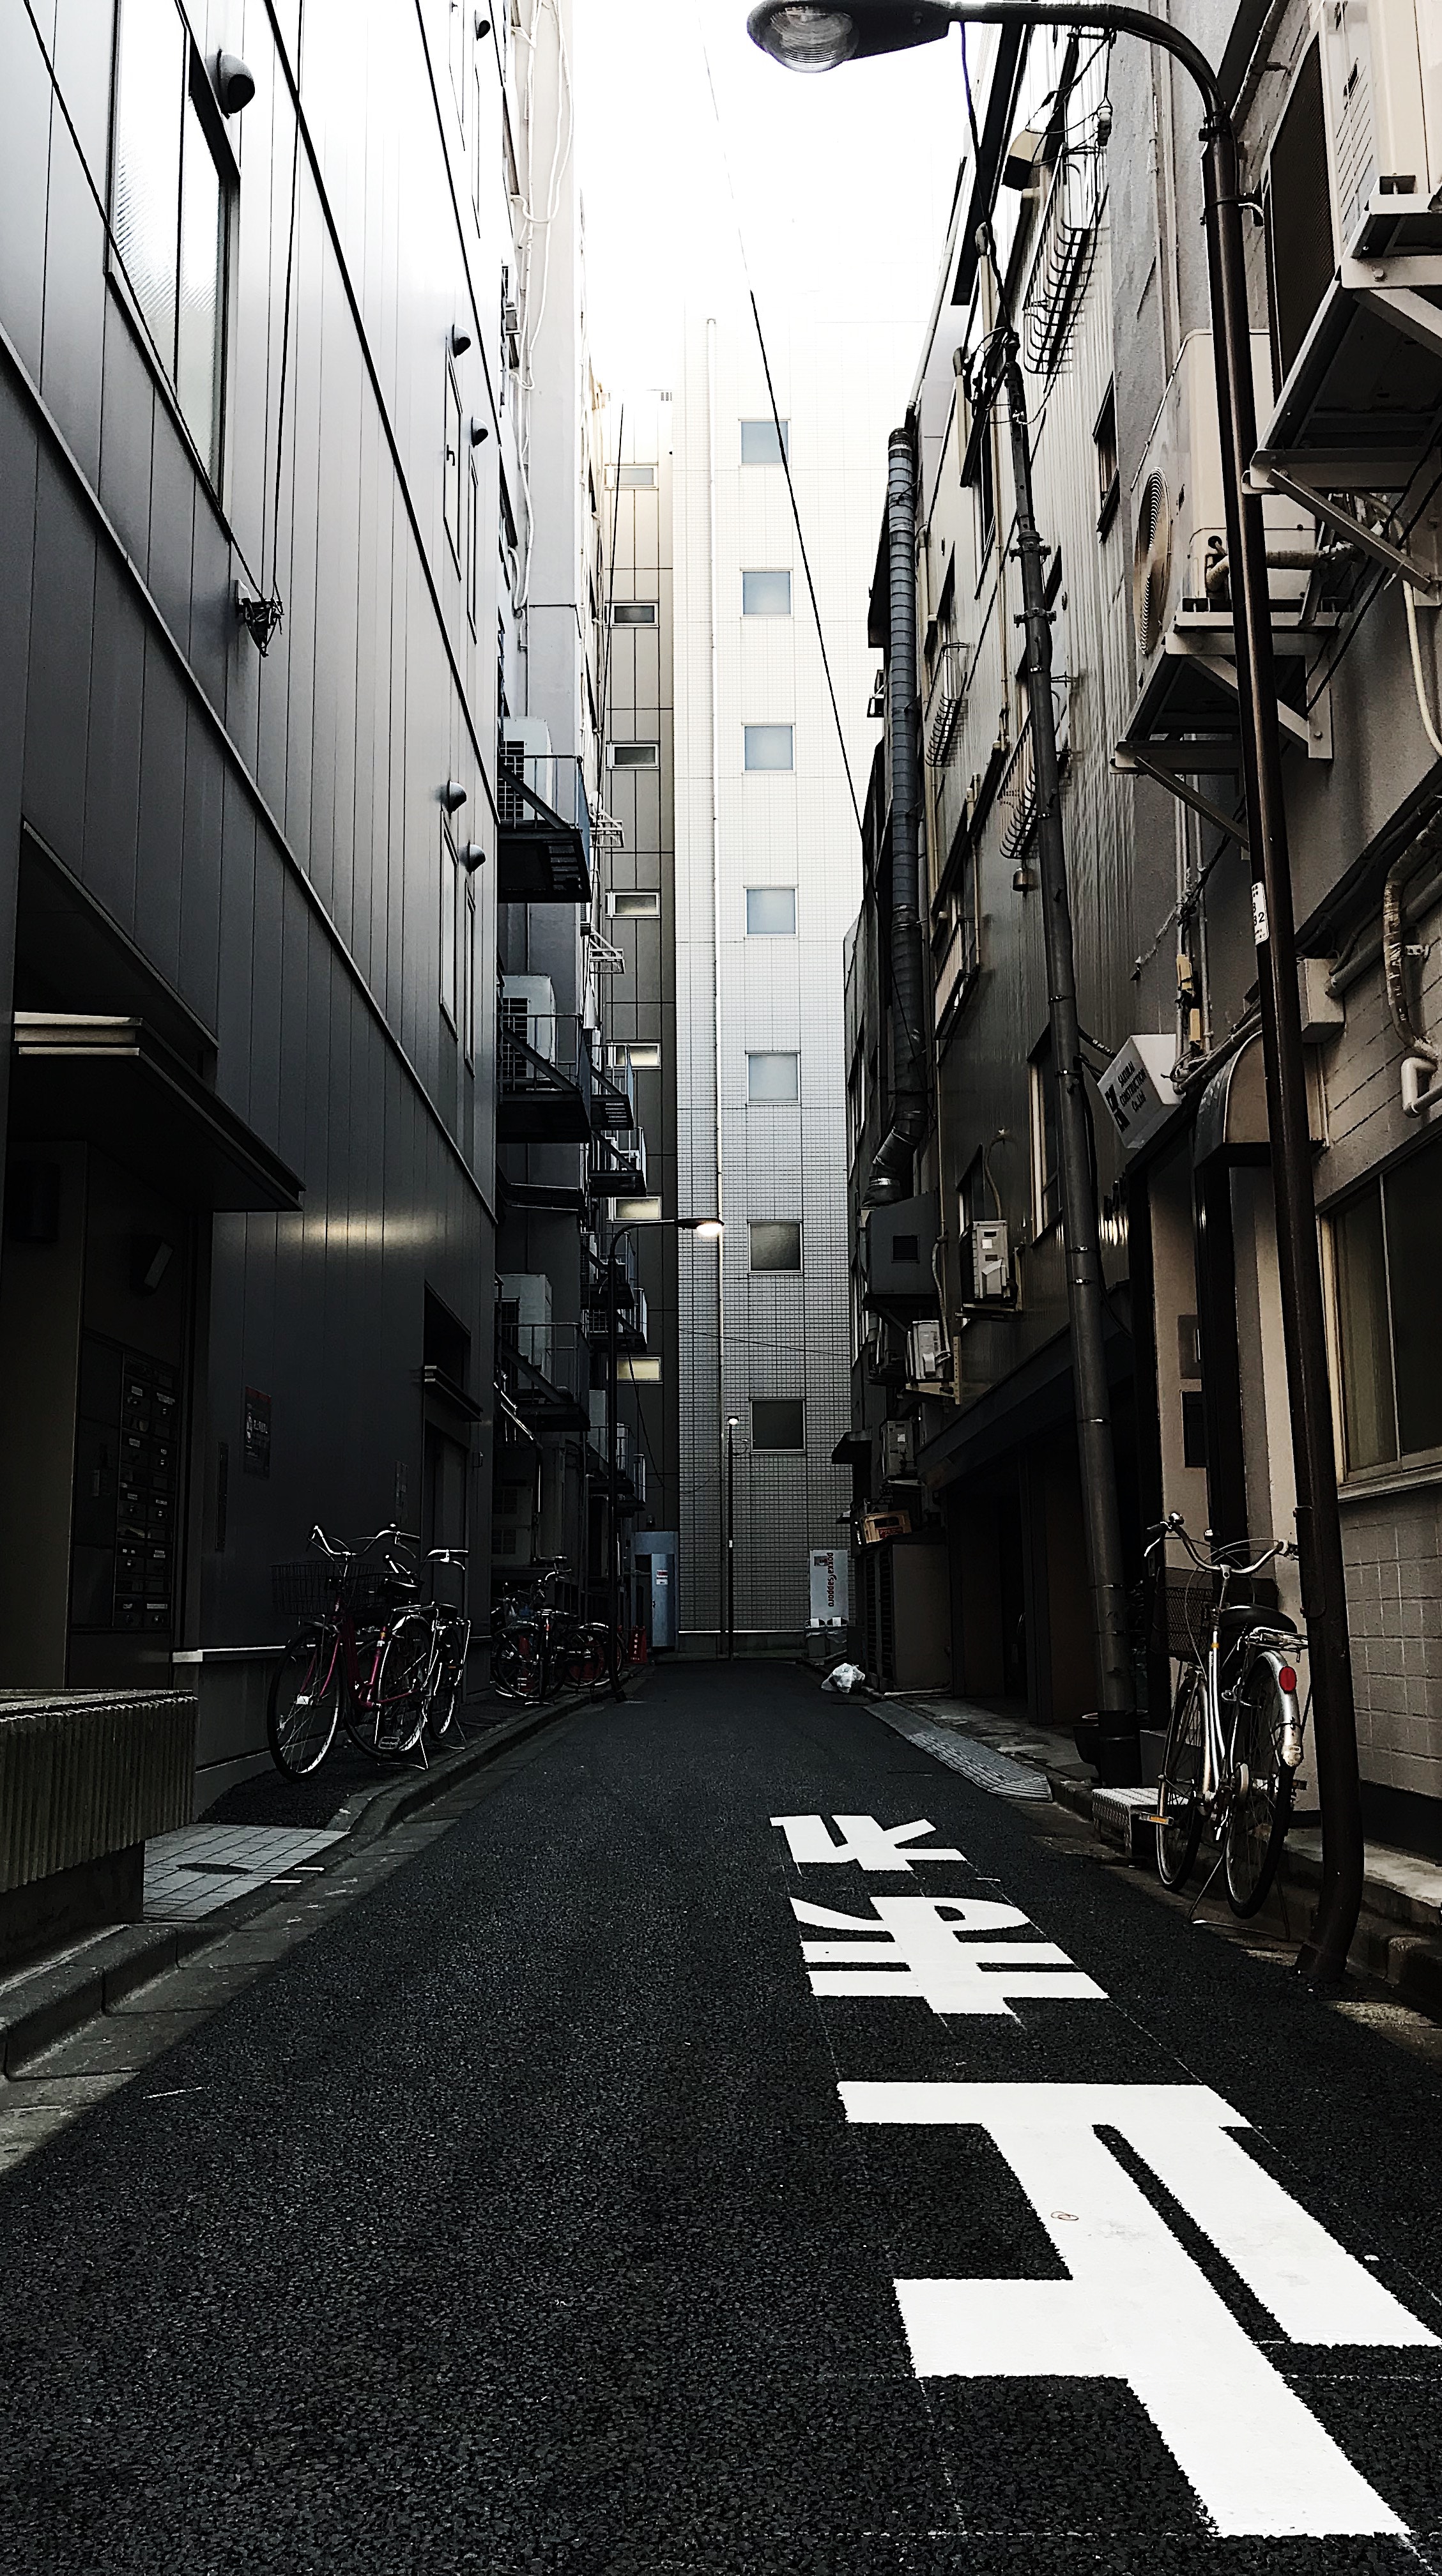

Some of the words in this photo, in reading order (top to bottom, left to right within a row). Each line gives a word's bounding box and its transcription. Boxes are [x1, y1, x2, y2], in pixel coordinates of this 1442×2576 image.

[1119, 1068, 1147, 1107] CONSTRUCTION
[826, 1577, 834, 1607] sapporo
[770, 1815, 1442, 2537] 止まれ
